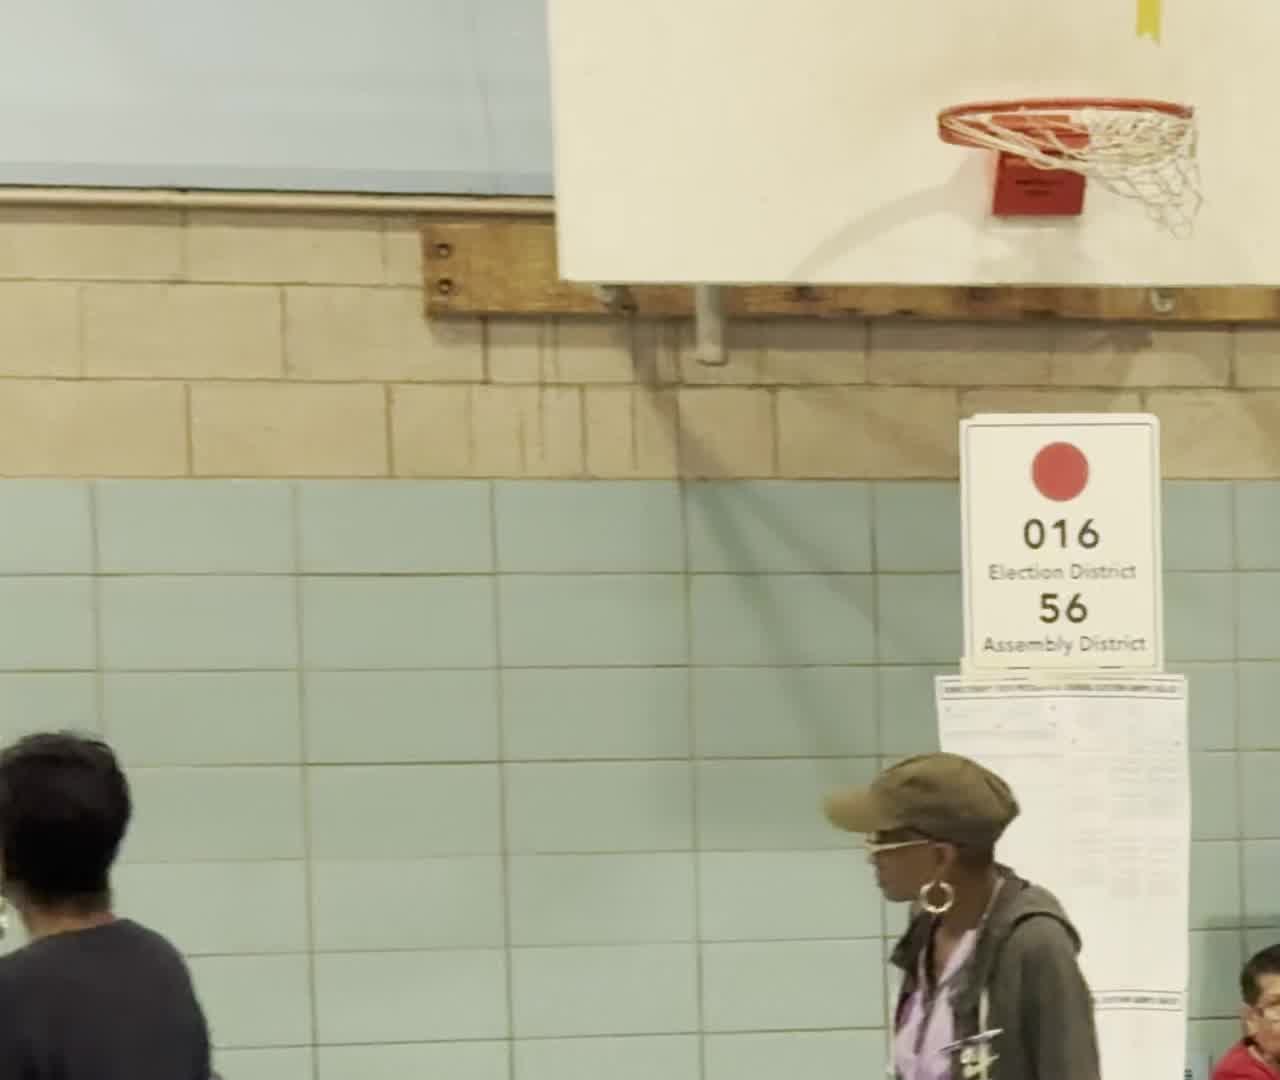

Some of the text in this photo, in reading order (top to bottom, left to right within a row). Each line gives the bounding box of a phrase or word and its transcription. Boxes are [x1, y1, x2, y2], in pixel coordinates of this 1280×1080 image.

[1023, 519, 1100, 549] 016
[988, 563, 1136, 580] Election District
[1039, 593, 1088, 623] 56
[984, 636, 1146, 656] Assembly District
